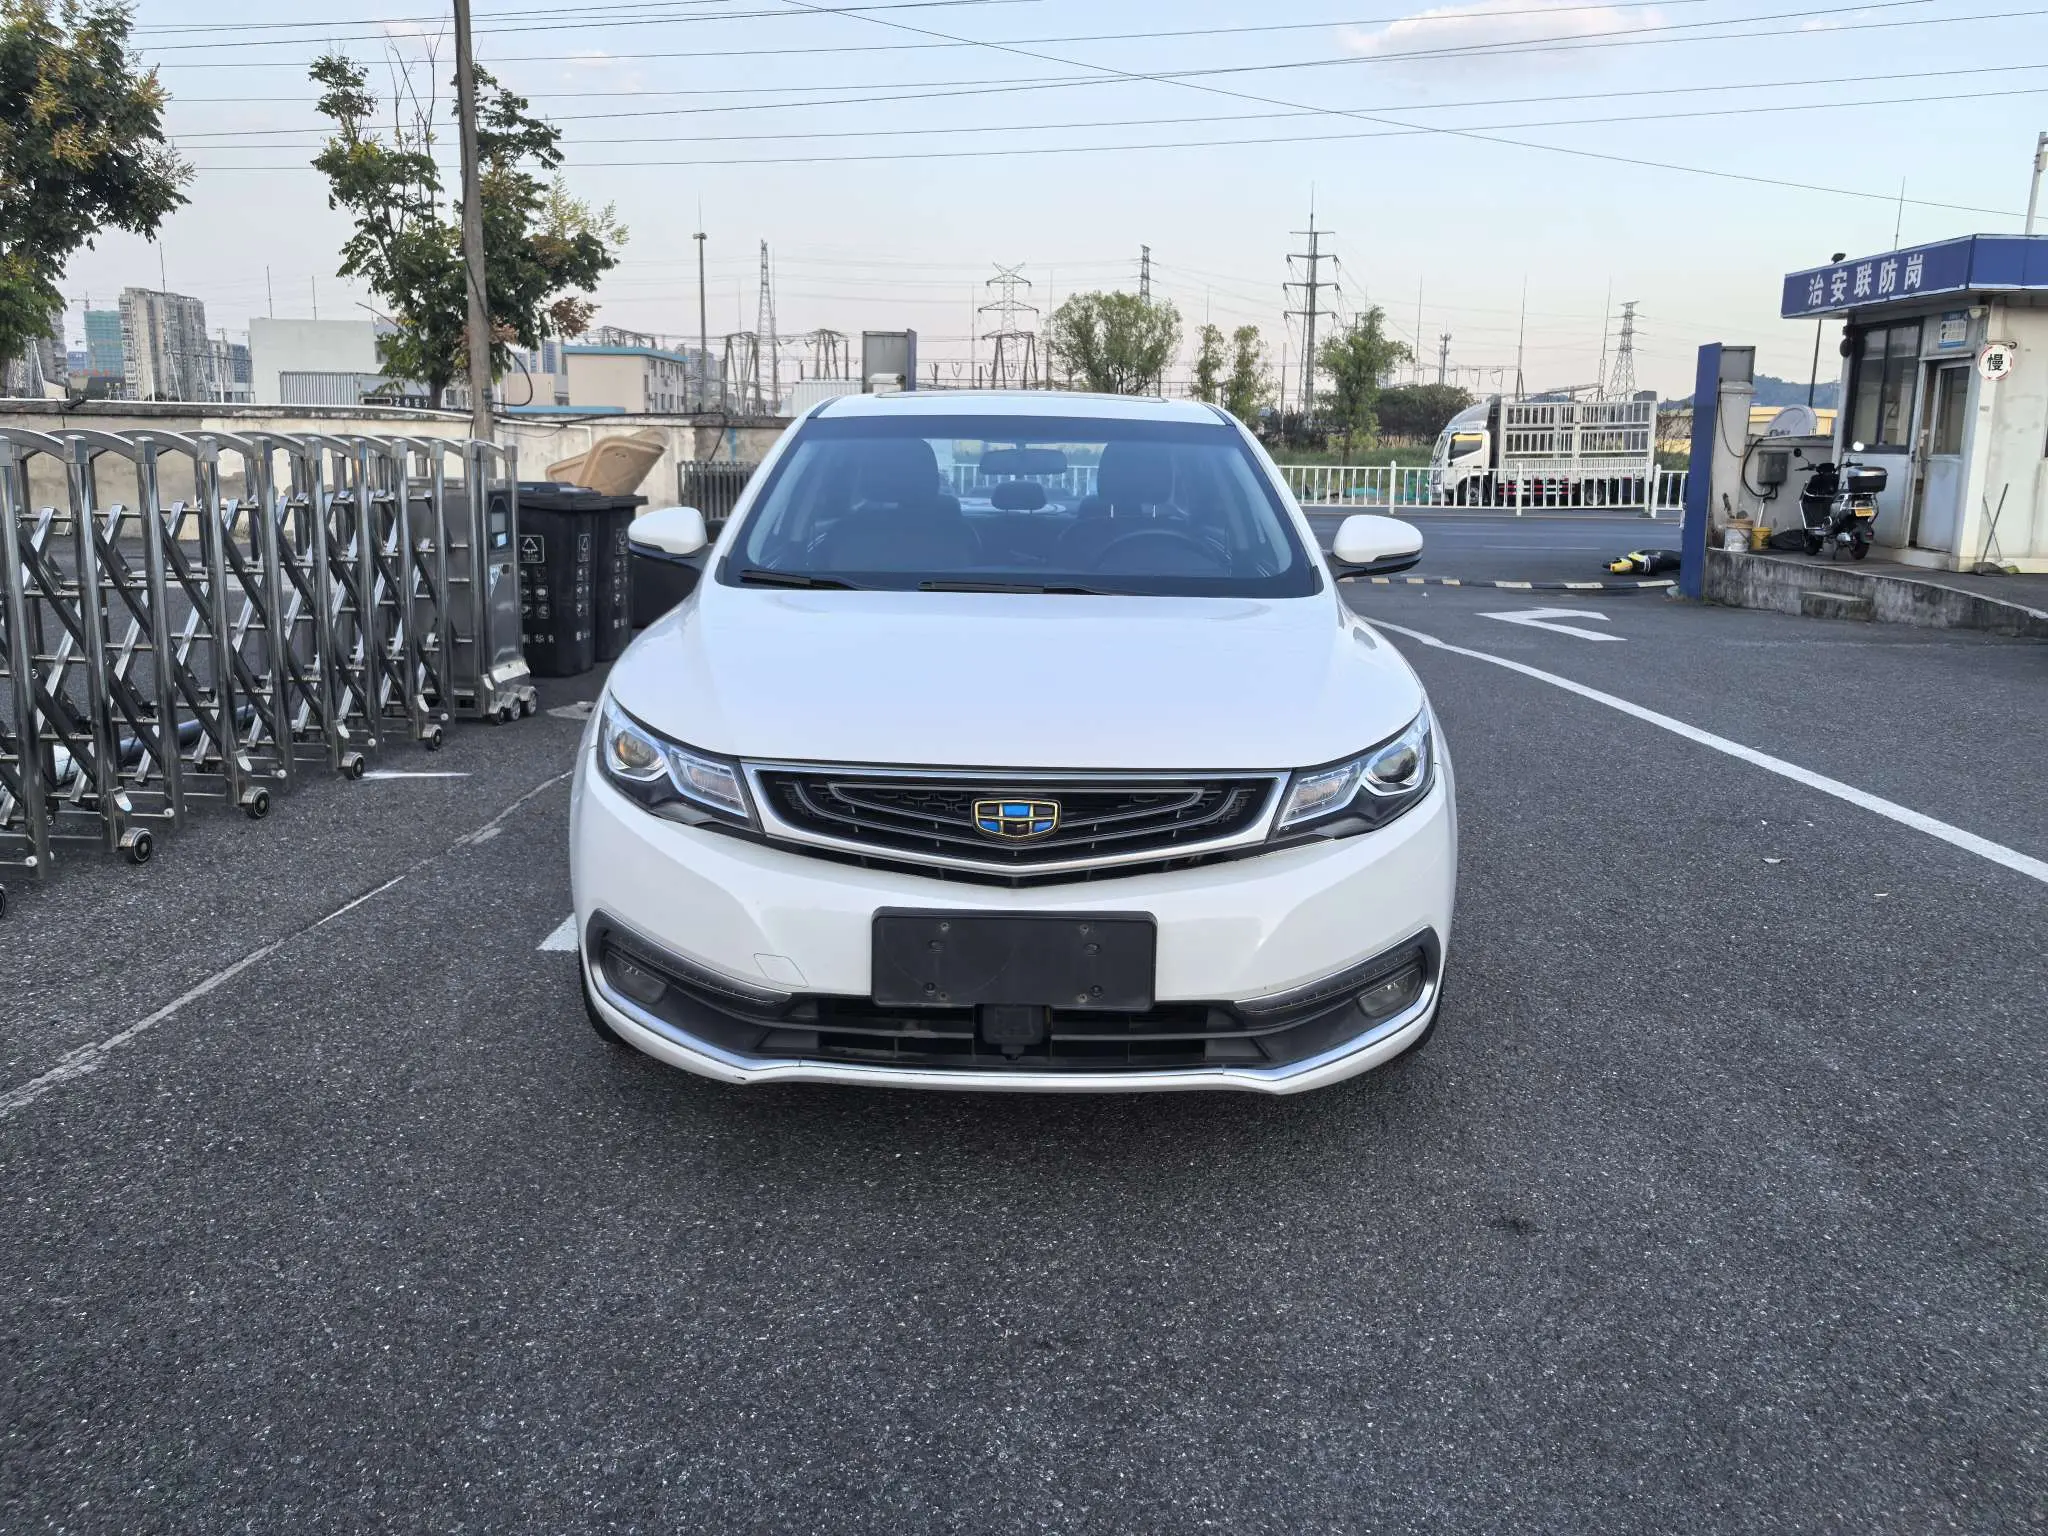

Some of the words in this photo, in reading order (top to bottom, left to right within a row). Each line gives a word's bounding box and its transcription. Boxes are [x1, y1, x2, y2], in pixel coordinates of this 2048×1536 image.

[1807, 253, 1924, 306] 治安联防岗
[1987, 353, 2004, 372] 慢
